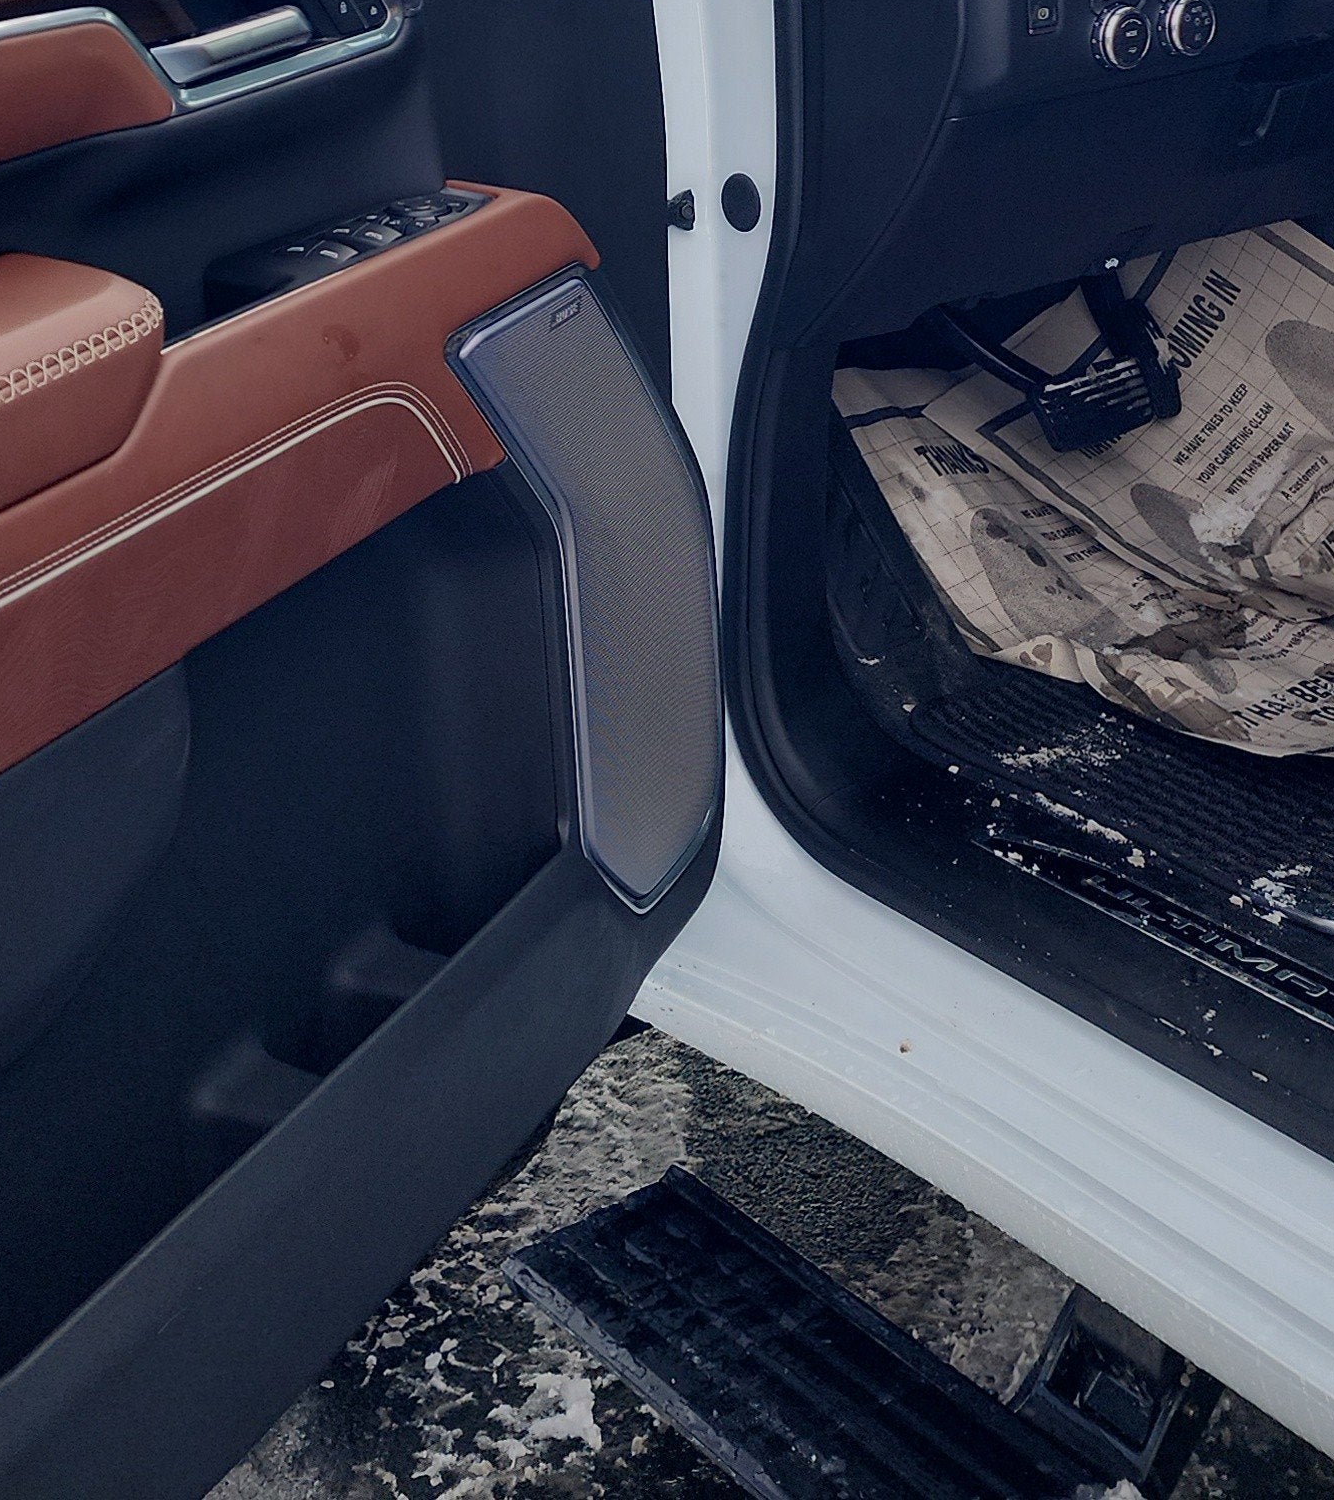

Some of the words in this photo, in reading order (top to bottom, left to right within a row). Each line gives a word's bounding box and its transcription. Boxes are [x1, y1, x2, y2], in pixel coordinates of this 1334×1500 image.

[1168, 293, 1226, 370] OMING
[1202, 268, 1242, 307] IN
[1173, 451, 1189, 466] WE
[1183, 434, 1206, 455] HAVE
[1200, 414, 1224, 437] TRIED
[1219, 404, 1233, 417] TO
[1228, 383, 1248, 407] KEEP
[1196, 462, 1220, 483] YOUR
[1214, 426, 1254, 465] CARPETING
[1249, 401, 1274, 429] CLEAN
[1225, 475, 1248, 495] WITH
[1241, 459, 1262, 478] THIS
[1257, 438, 1284, 463] PAPER
[1277, 421, 1296, 442] MAT
[1281, 490, 1292, 500] A
